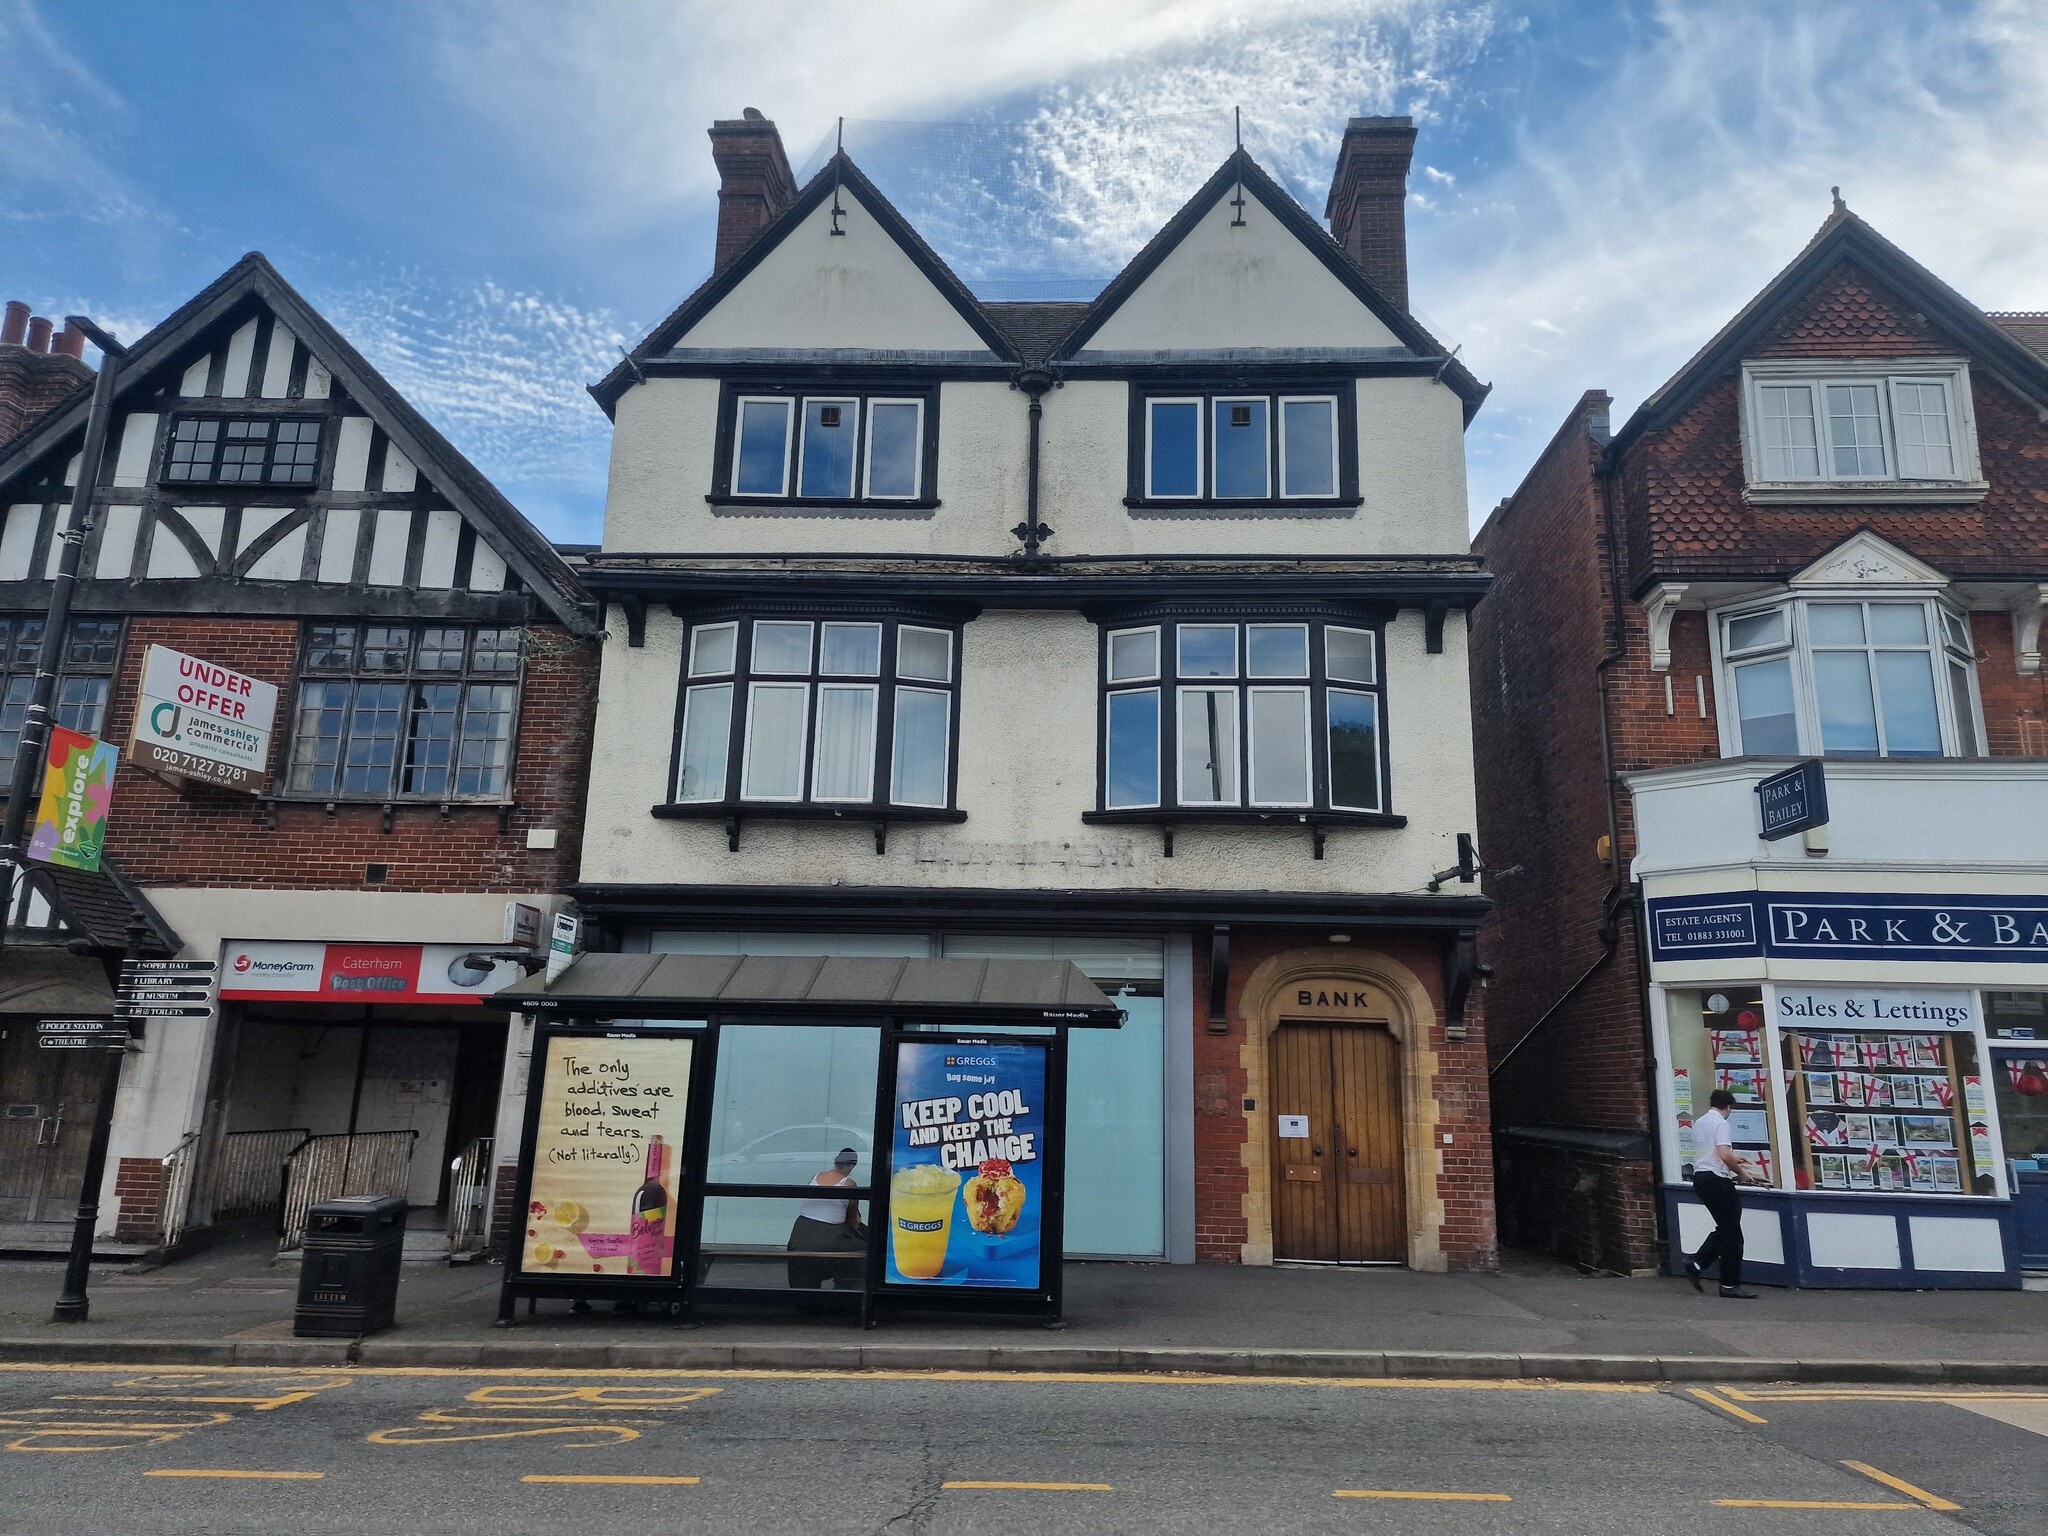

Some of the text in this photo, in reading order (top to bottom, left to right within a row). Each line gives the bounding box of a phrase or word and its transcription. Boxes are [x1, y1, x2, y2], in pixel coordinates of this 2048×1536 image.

[180, 657, 252, 697] UNDER
[178, 684, 246, 720] OFFER
[186, 726, 258, 754] commercial
[189, 717, 260, 745] james ashley
[190, 741, 253, 762] property consultants
[153, 747, 248, 782] 020 7127 8781
[165, 762, 232, 786] james-ashley.co.uk
[63, 754, 90, 844] explore
[1765, 780, 1803, 803] PARK &
[1768, 802, 1803, 824] BAILEY
[1665, 914, 1742, 926] ESTATE AGENTS
[1781, 910, 1912, 942] PARK
[1931, 912, 1970, 944] &
[1664, 930, 1746, 942] TEL 01883 331001
[142, 962, 190, 970] SOPER HALL
[252, 961, 314, 973] MoneyGram
[342, 956, 402, 970] Caterham
[333, 976, 406, 990] Post Office
[1298, 990, 1368, 1008] BANK
[150, 1008, 184, 1016] TOILETS
[1780, 995, 1968, 1028] Sales & Lettings
[54, 1038, 88, 1046] THEATRE
[563, 1056, 630, 1080] The only
[956, 1056, 996, 1066] GREGGS
[946, 1073, 961, 1083] Bag
[962, 1074, 982, 1083] some
[568, 1080, 674, 1098] additives are
[564, 1102, 660, 1119] blood, sweat
[902, 1089, 1030, 1128] KEEP COOL
[560, 1121, 644, 1139] and tears.
[909, 1118, 1014, 1146] AND KEEP THE
[548, 1148, 578, 1164] (Not
[582, 1143, 640, 1164] literally.)
[940, 1134, 1036, 1170] CHANGE
[907, 1222, 942, 1230] GREGGS
[314, 1292, 347, 1302] LITTER
